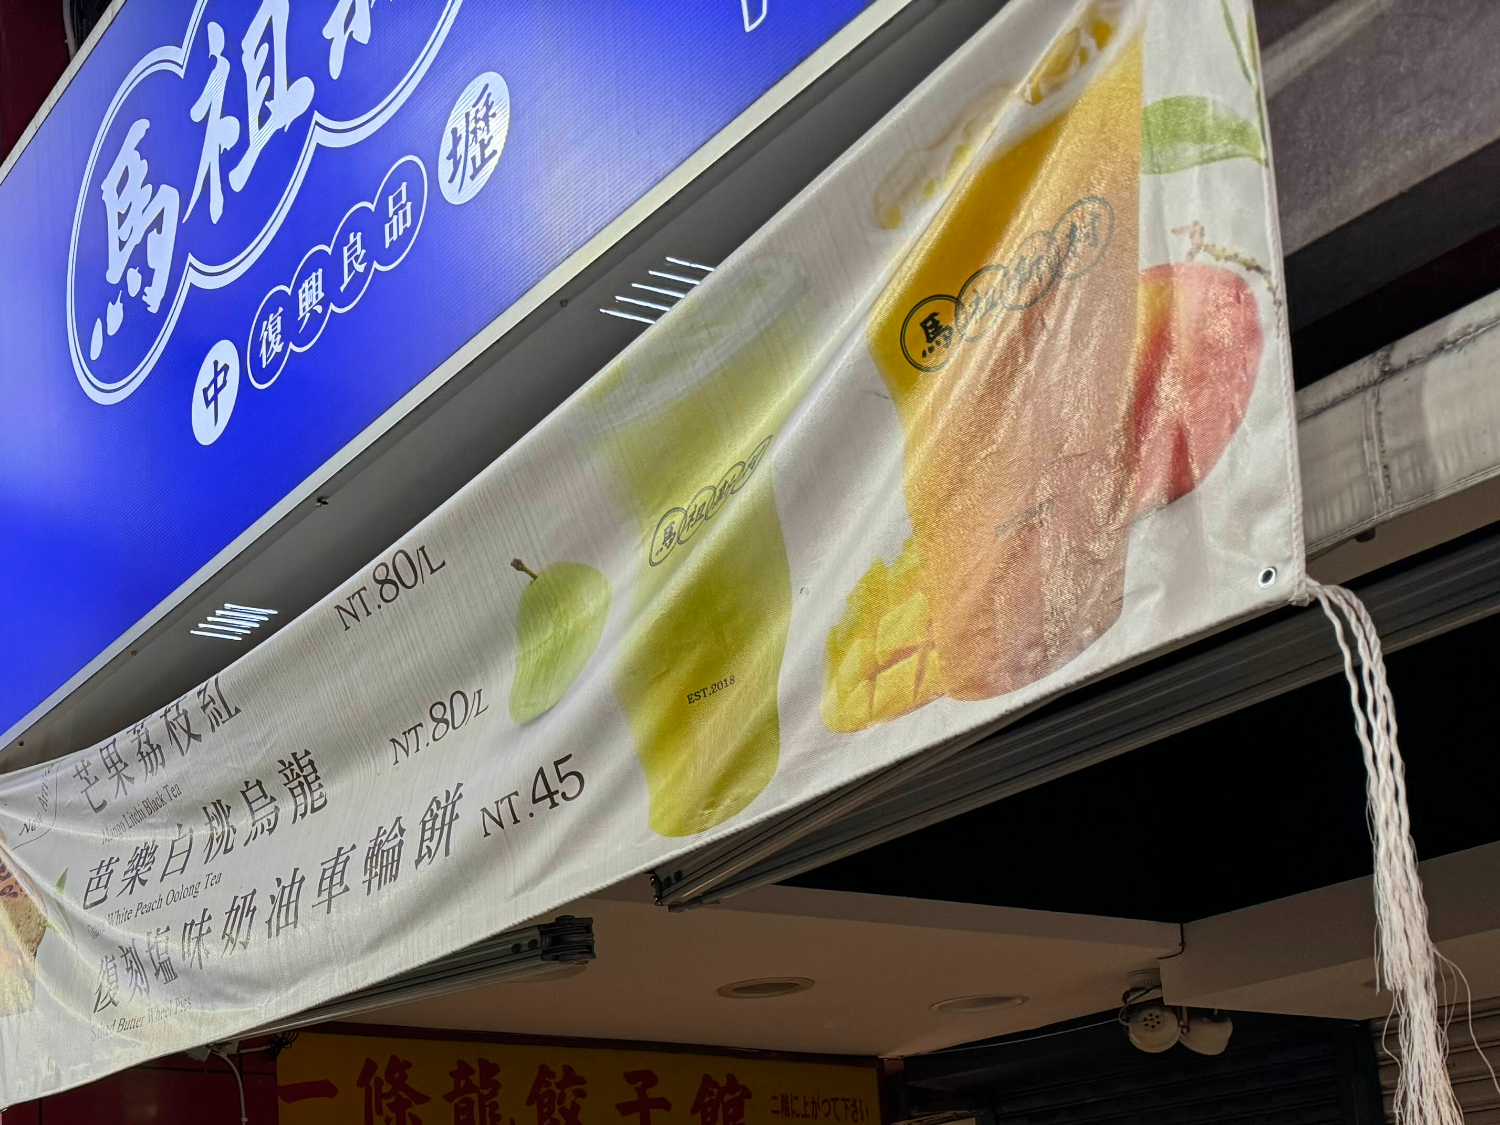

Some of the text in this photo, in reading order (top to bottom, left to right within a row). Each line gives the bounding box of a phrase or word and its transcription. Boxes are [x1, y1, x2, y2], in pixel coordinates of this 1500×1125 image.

[202, 359, 229, 427] 中
[258, 180, 414, 370] 復興良品
[81, 747, 330, 910] 芭樂白桃烏龍
[122, 808, 146, 834] Litchi
[144, 791, 167, 817] Black
[163, 782, 182, 803] Tea
[107, 906, 133, 926] White
[134, 897, 164, 919] Peach
[165, 881, 202, 906] Oolong
[203, 872, 223, 890] Tea
[116, 1015, 145, 1034] Butter
